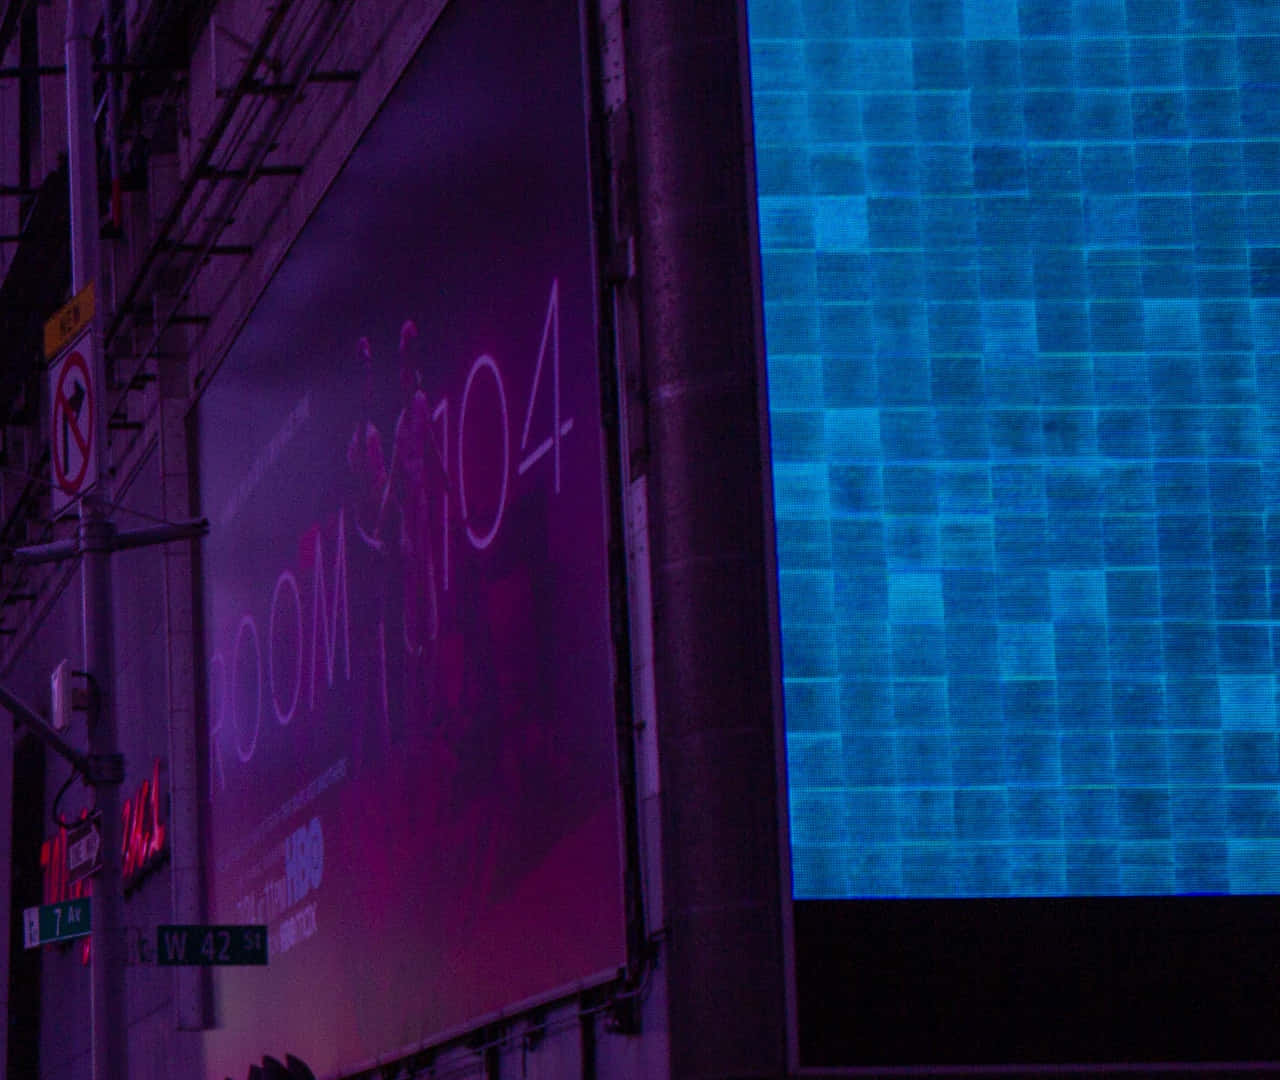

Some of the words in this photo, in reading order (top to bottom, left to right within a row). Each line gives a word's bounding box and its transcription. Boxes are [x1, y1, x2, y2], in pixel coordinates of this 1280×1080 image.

[53, 907, 62, 937] 7
[163, 930, 189, 962] W
[200, 930, 232, 961] 42
